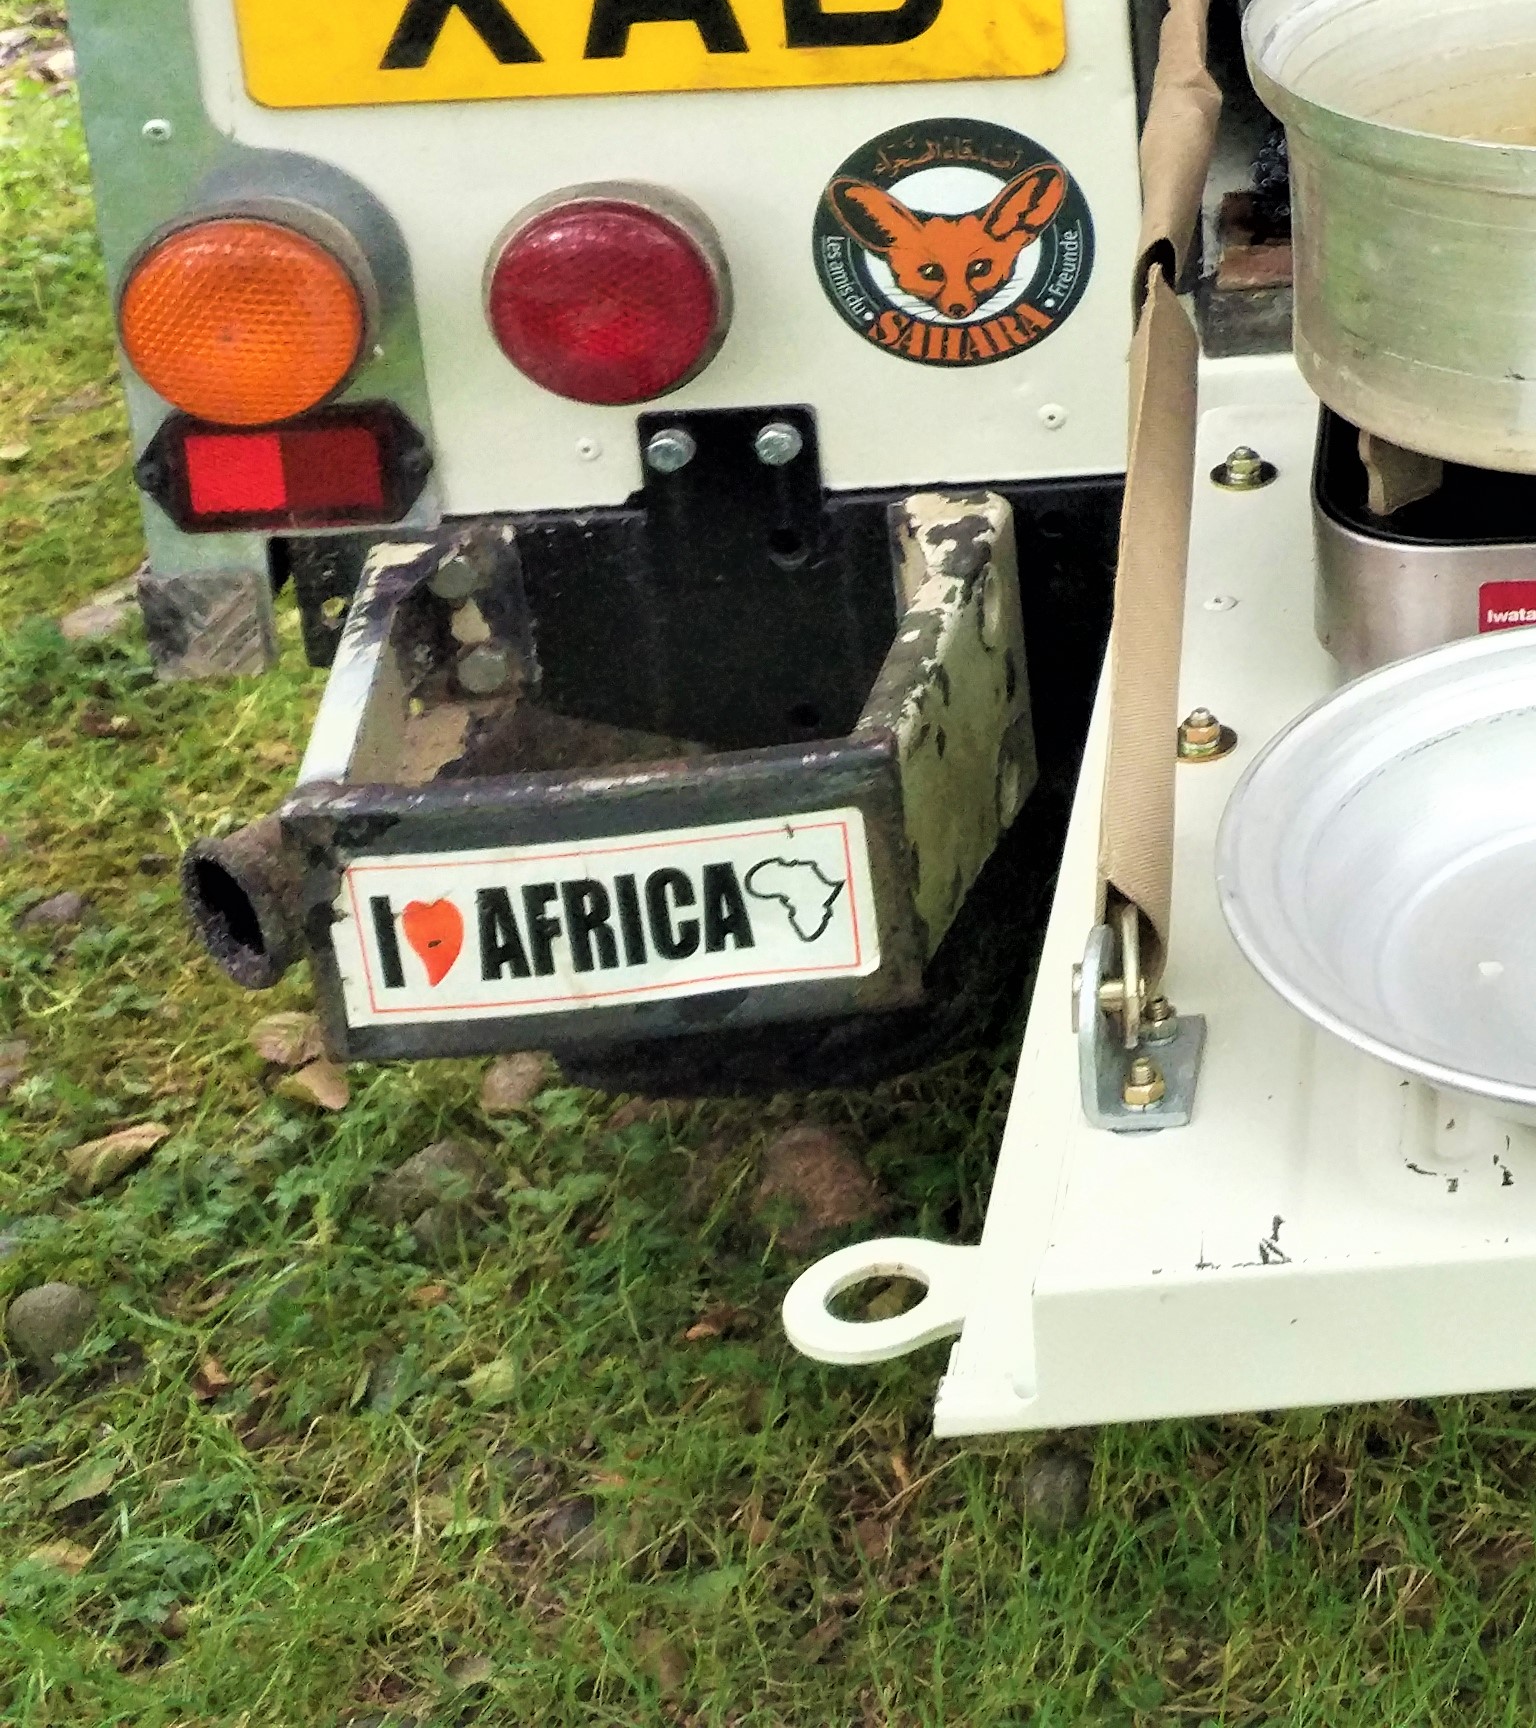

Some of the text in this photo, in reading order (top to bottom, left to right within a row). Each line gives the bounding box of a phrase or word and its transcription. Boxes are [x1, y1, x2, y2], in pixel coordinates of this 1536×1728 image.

[1049, 229, 1079, 298] Freunde
[868, 303, 1054, 361] SAHARA
[369, 862, 755, 989] I AFRICA
